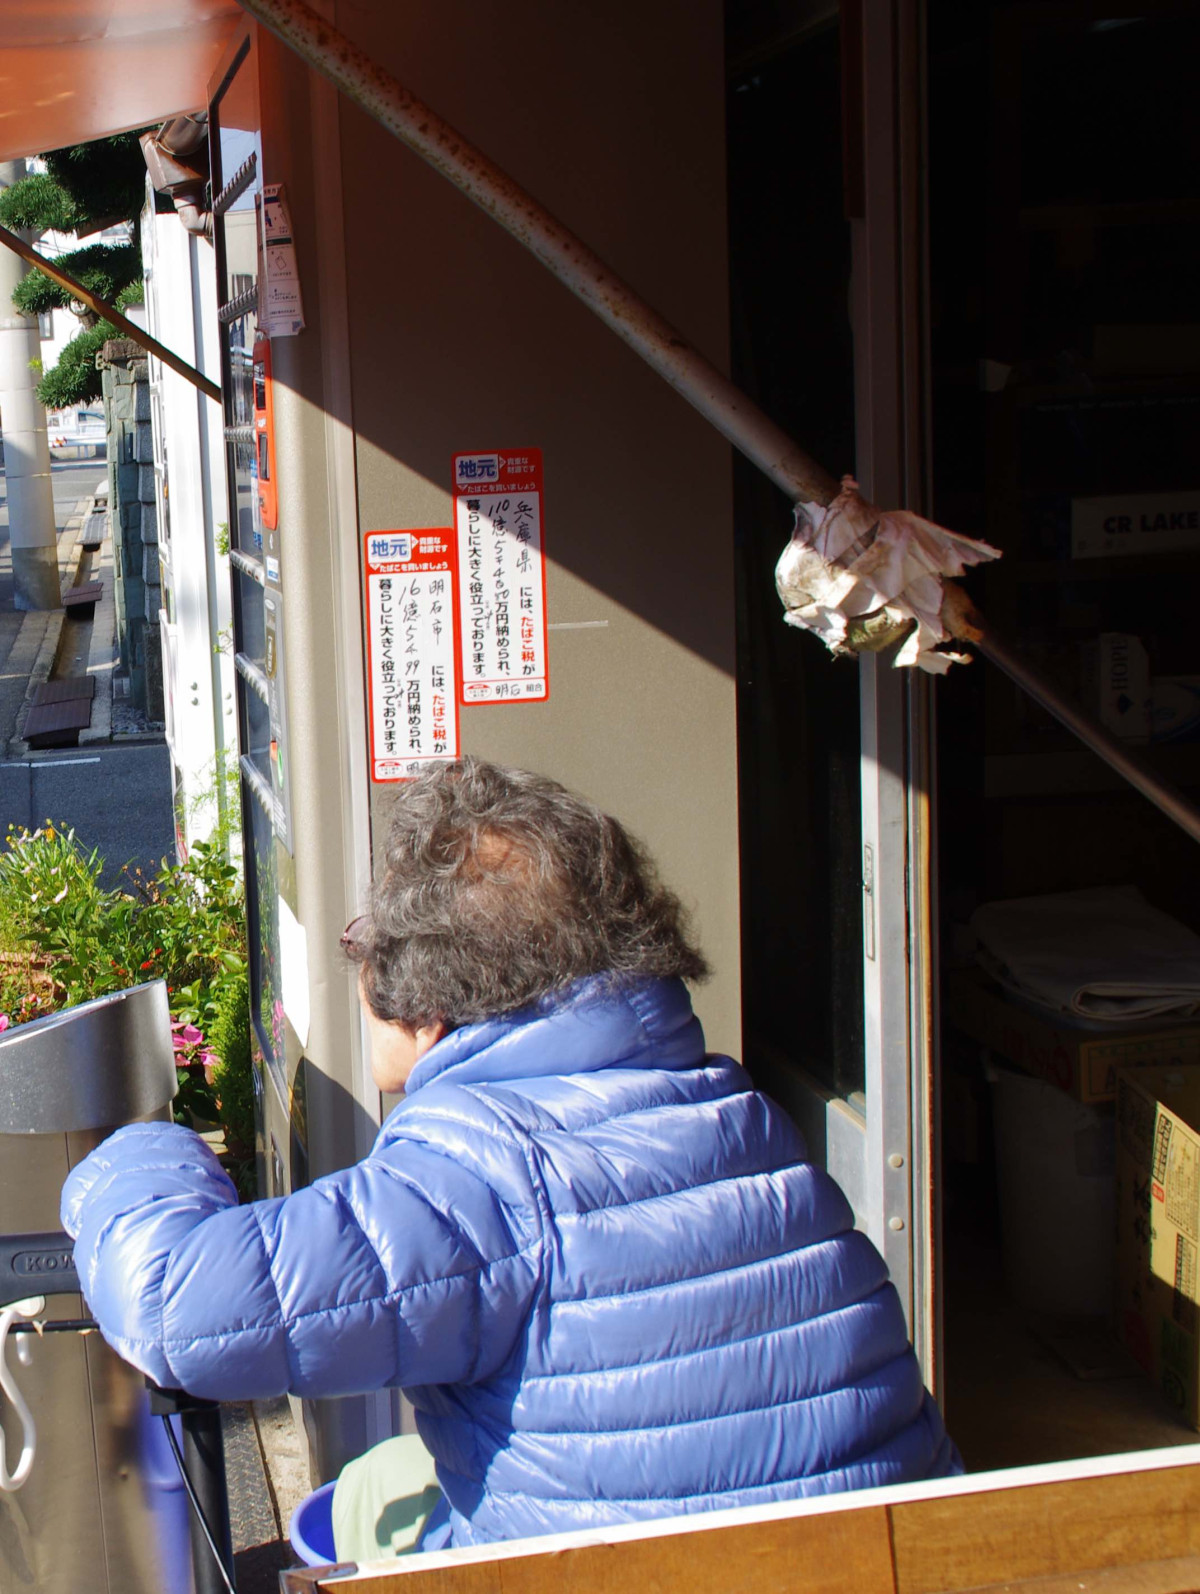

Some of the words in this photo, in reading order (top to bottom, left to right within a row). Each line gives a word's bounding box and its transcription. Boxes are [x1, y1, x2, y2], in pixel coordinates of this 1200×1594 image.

[458, 460, 496, 478] 地元
[1103, 515, 1132, 534] CR
[1141, 511, 1199, 533] LAKE
[371, 539, 408, 557] 地元
[466, 499, 486, 678] 暮らしに大きく役立っております。
[379, 578, 398, 756] 暮らしに大きく役立っております。
[1111, 639, 1129, 690] HOPE
